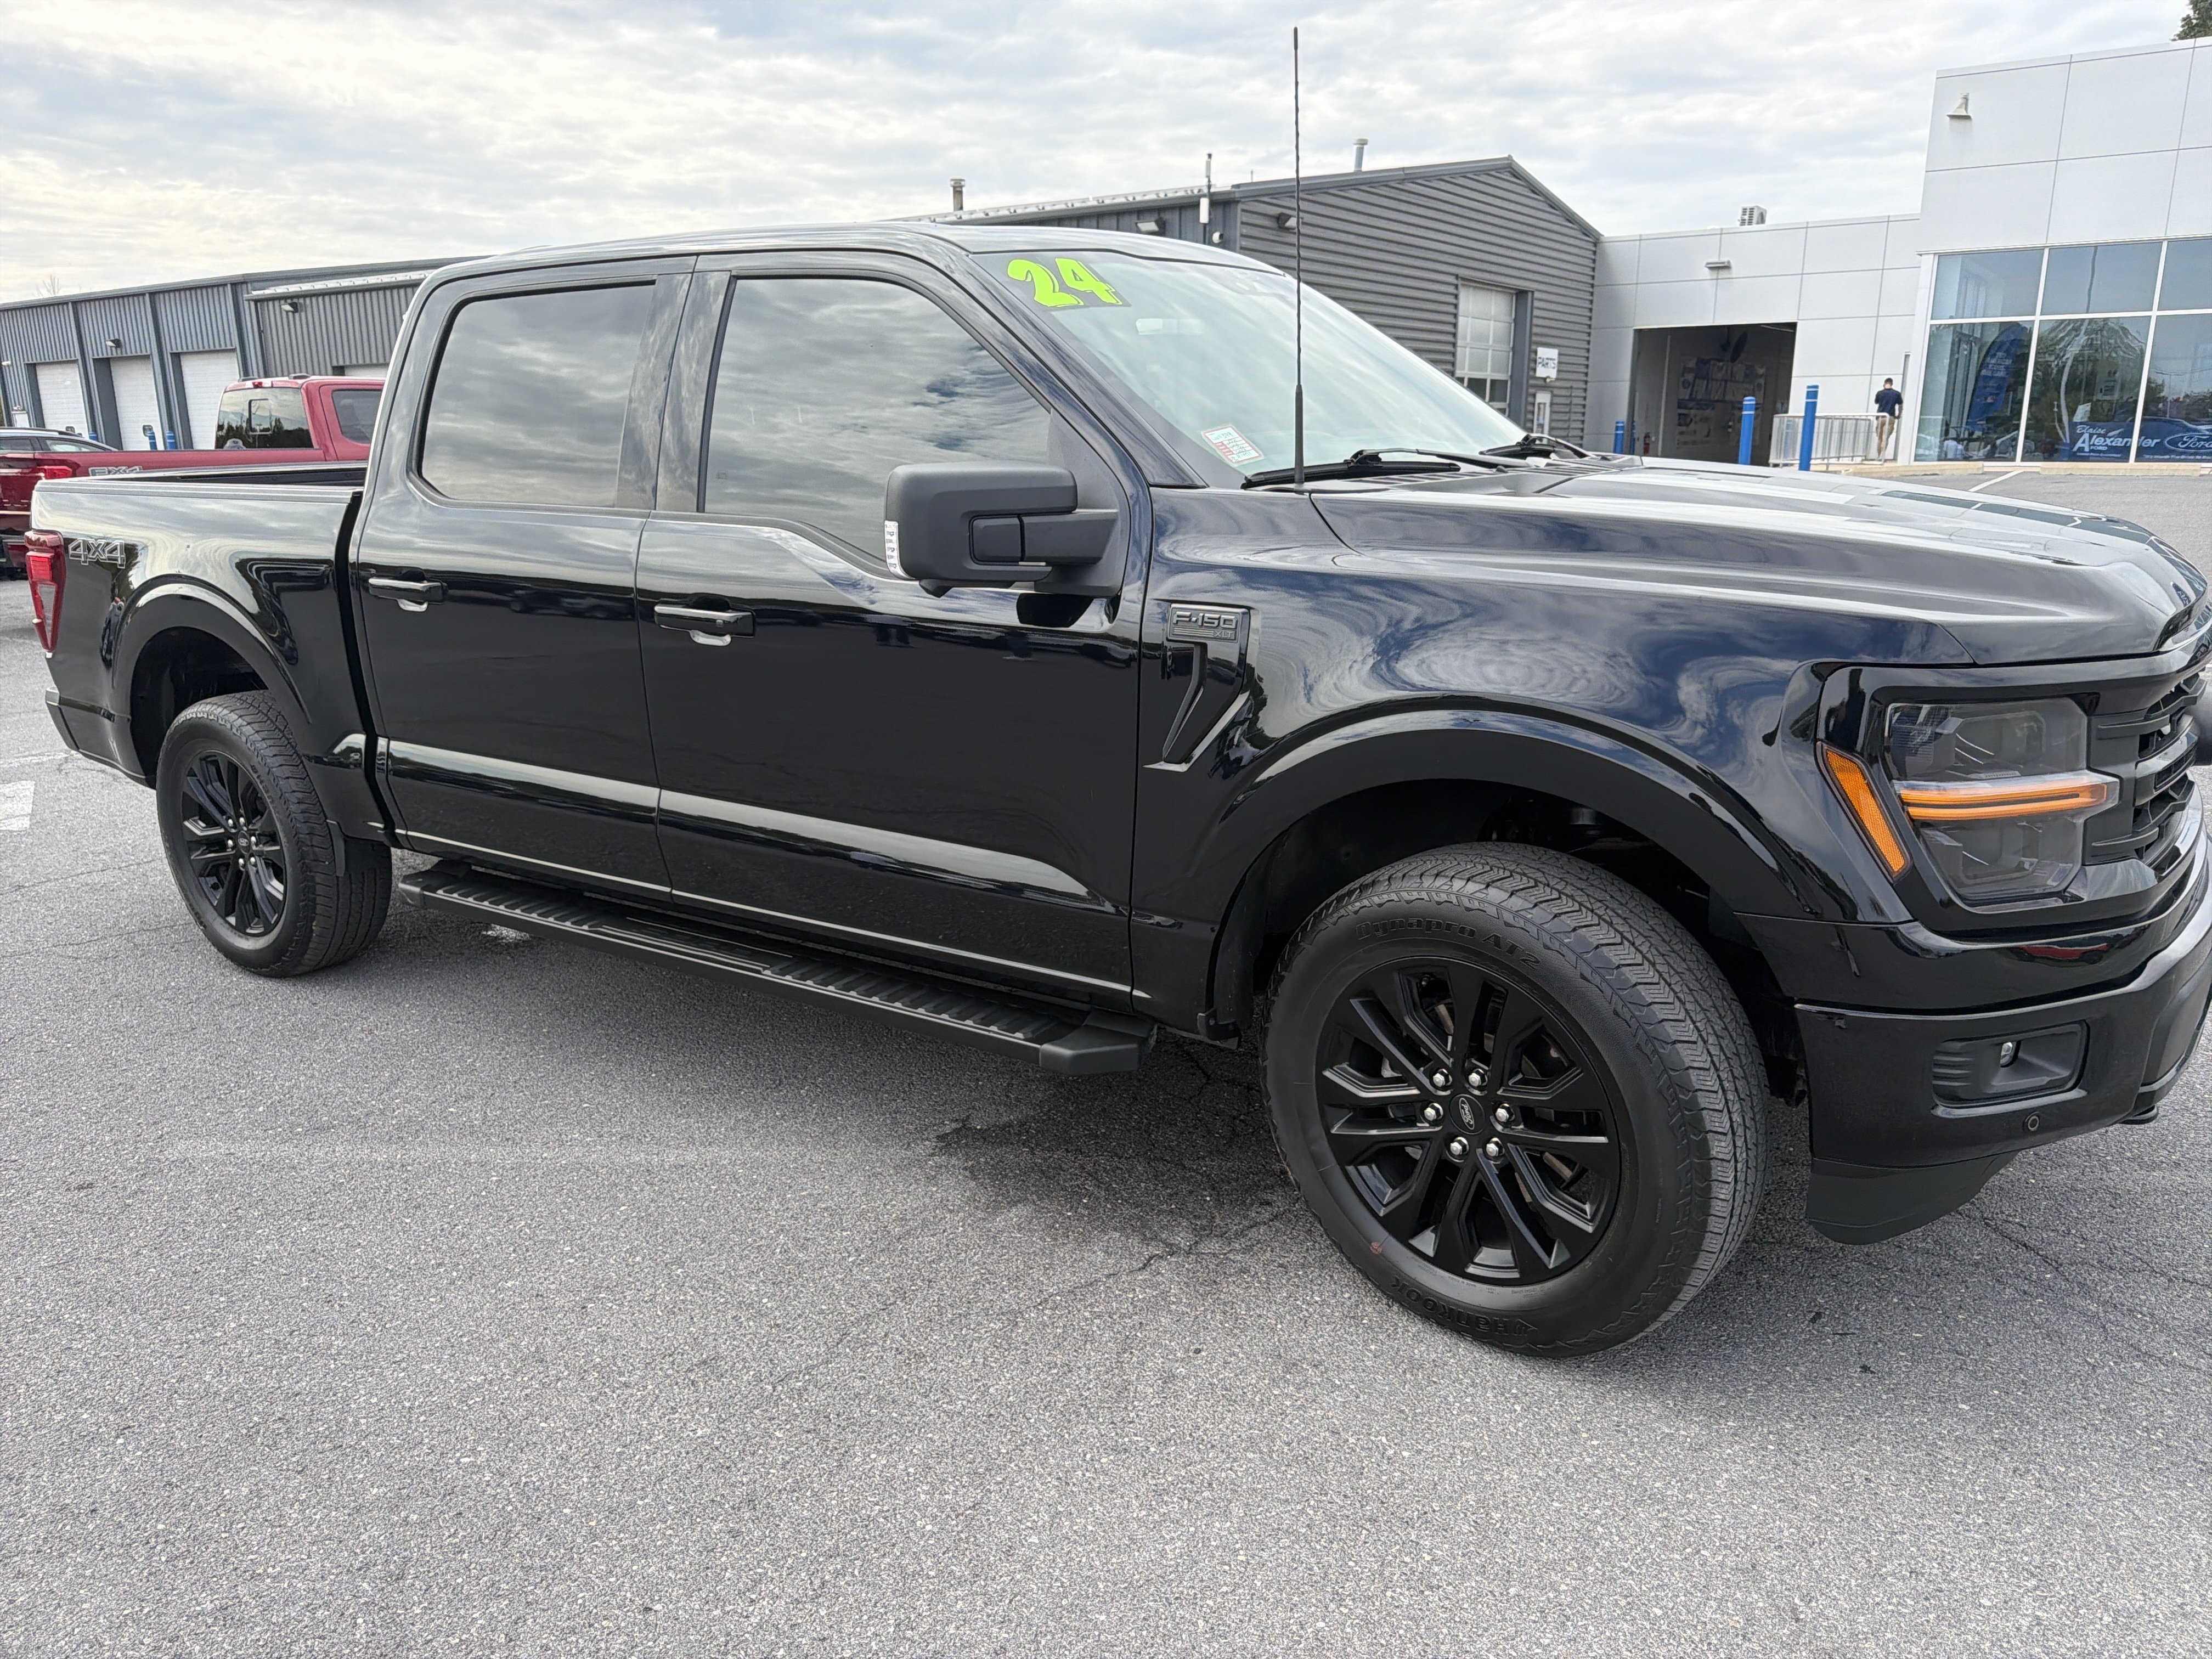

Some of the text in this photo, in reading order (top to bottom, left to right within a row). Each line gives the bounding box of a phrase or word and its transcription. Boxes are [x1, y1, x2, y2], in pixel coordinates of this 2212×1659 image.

[1008, 258, 1123, 307] 24
[1538, 357, 1556, 369] PARTS
[2076, 425, 2107, 434] Blaise
[1172, 611, 1238, 629] F-150
[1214, 630, 1233, 639] XLT
[1356, 918, 1540, 970] Dynapro AT2
[1461, 1103, 1473, 1125] Ford
